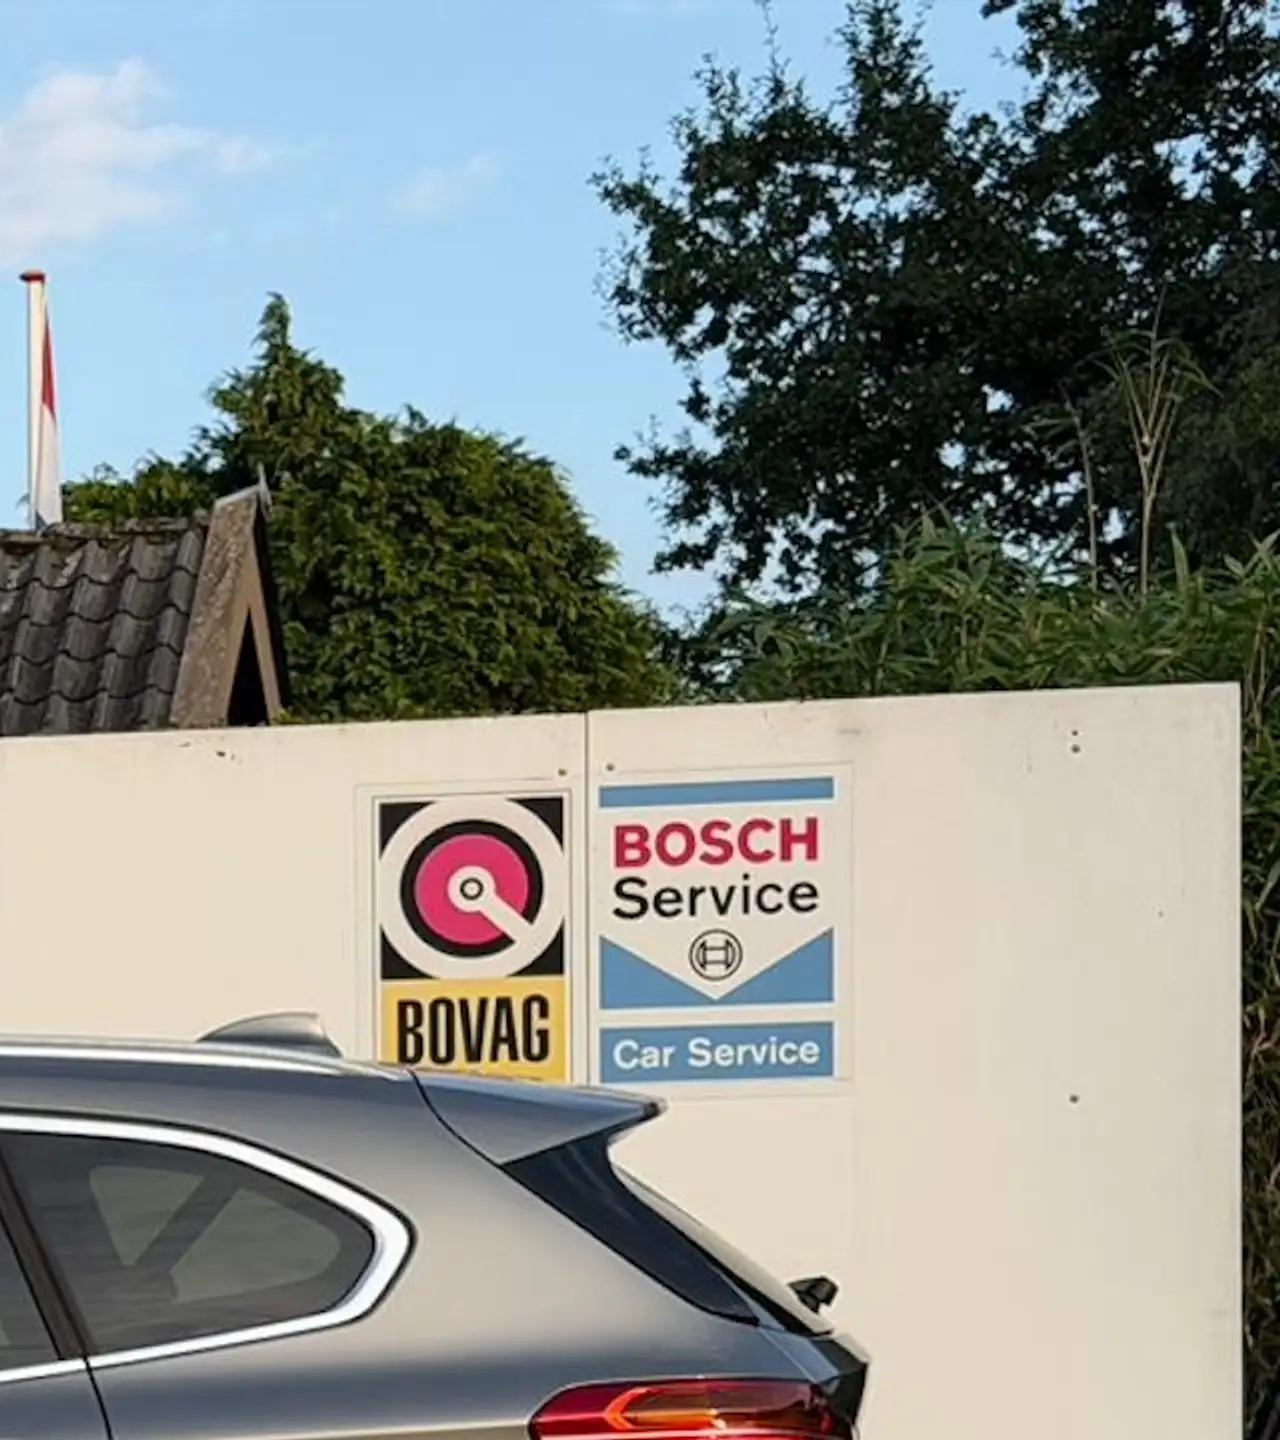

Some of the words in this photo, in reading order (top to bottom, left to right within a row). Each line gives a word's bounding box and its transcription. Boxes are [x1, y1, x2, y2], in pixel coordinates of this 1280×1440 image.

[613, 817, 819, 867] BOSCH
[612, 874, 820, 919] Service
[396, 995, 550, 1065] BOVAG
[613, 1039, 674, 1069] Car
[687, 1036, 821, 1067] Service
